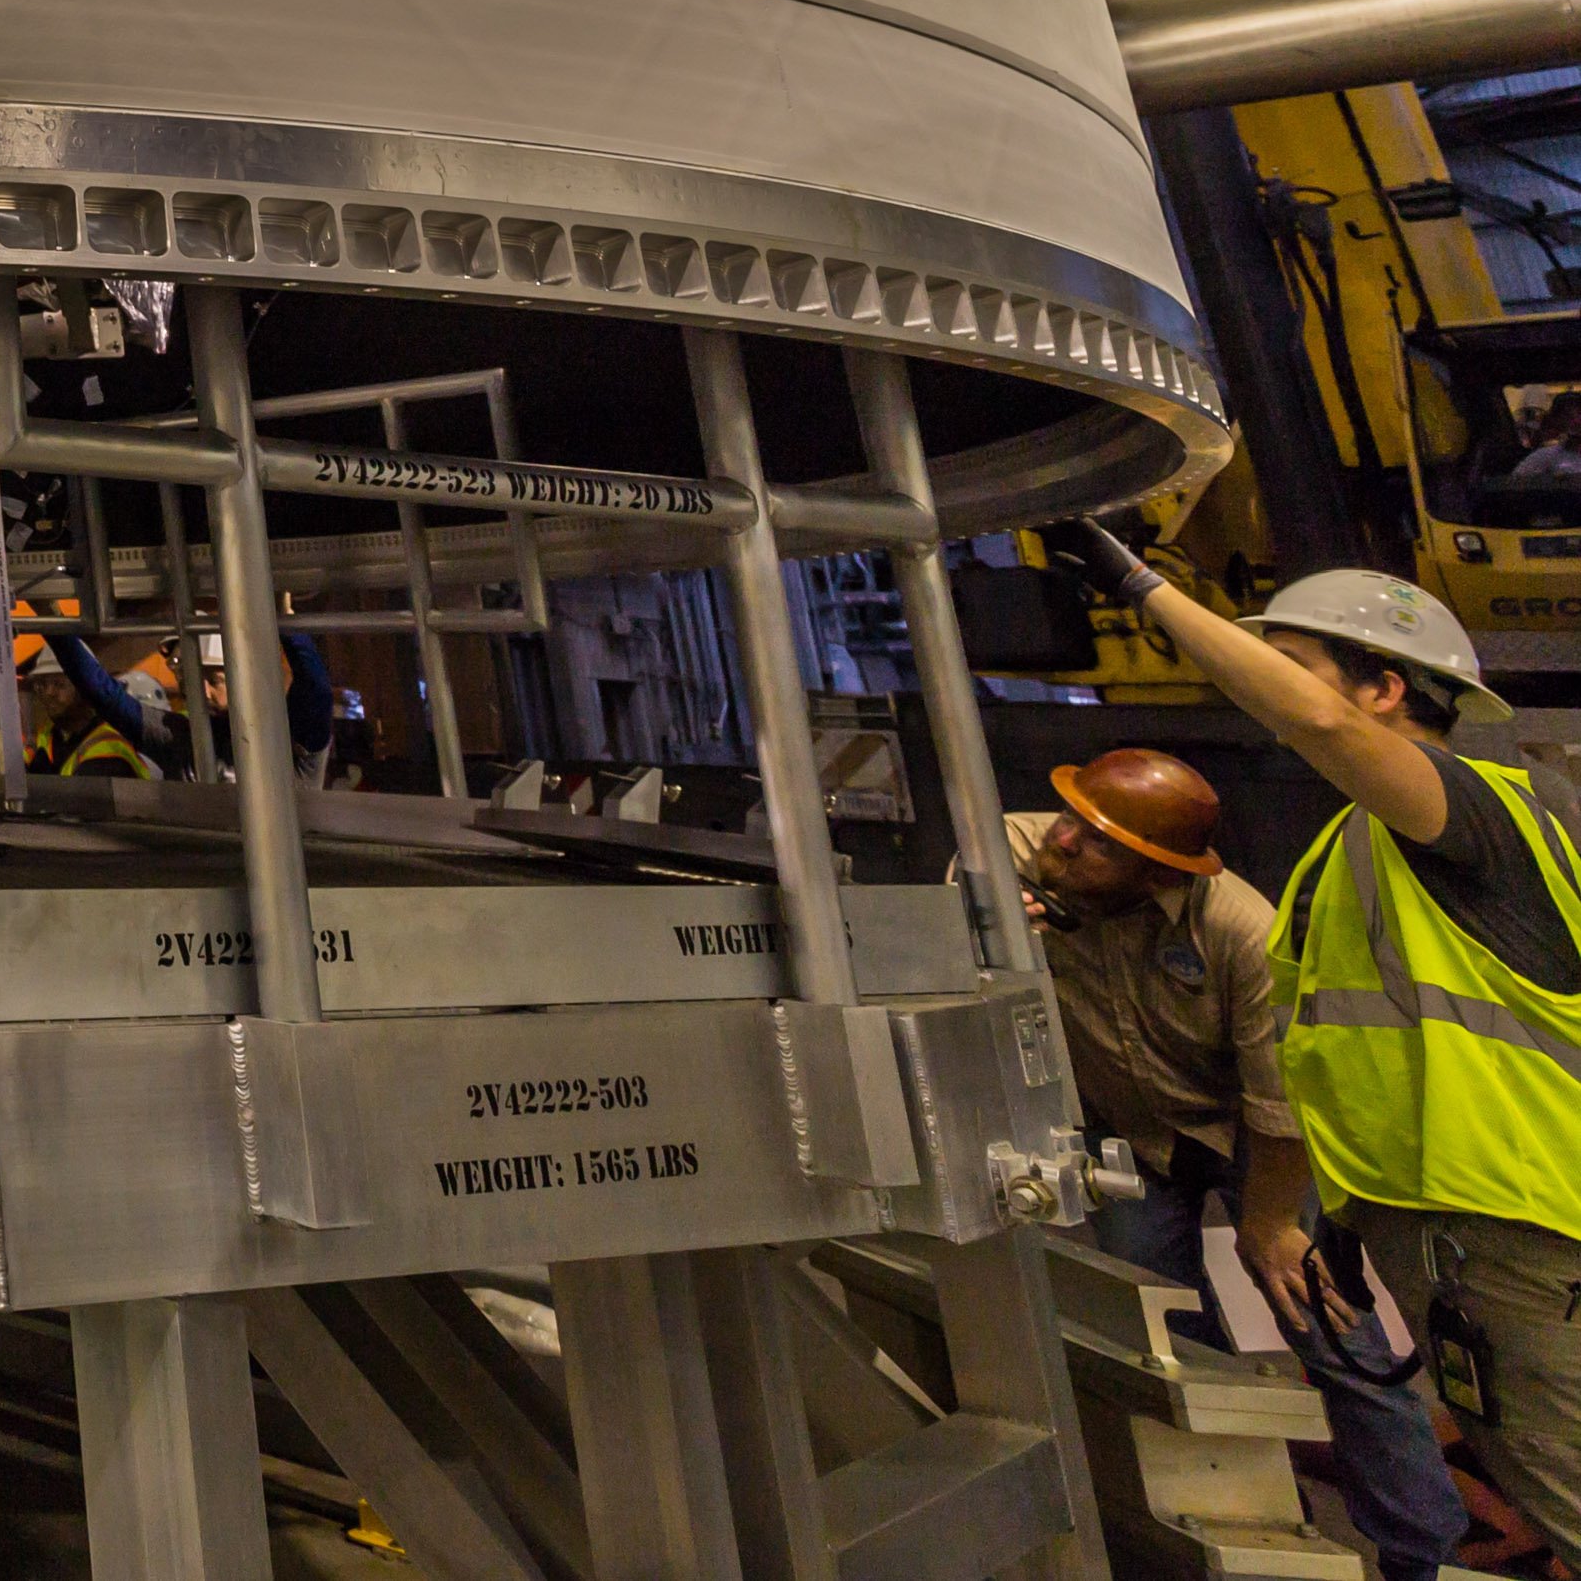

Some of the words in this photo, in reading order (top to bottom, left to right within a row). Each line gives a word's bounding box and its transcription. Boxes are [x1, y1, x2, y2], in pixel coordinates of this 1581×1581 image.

[314, 452, 496, 497] 2V42222-523
[506, 471, 622, 509] WEIGHT:
[628, 483, 661, 511] 20
[666, 486, 714, 515] LBS
[156, 929, 355, 968] 2V42231
[466, 1074, 650, 1119] 2V42222-503
[434, 1153, 566, 1198] WEIGHT:
[573, 1146, 641, 1186] 1565
[646, 1142, 700, 1180] LBS
